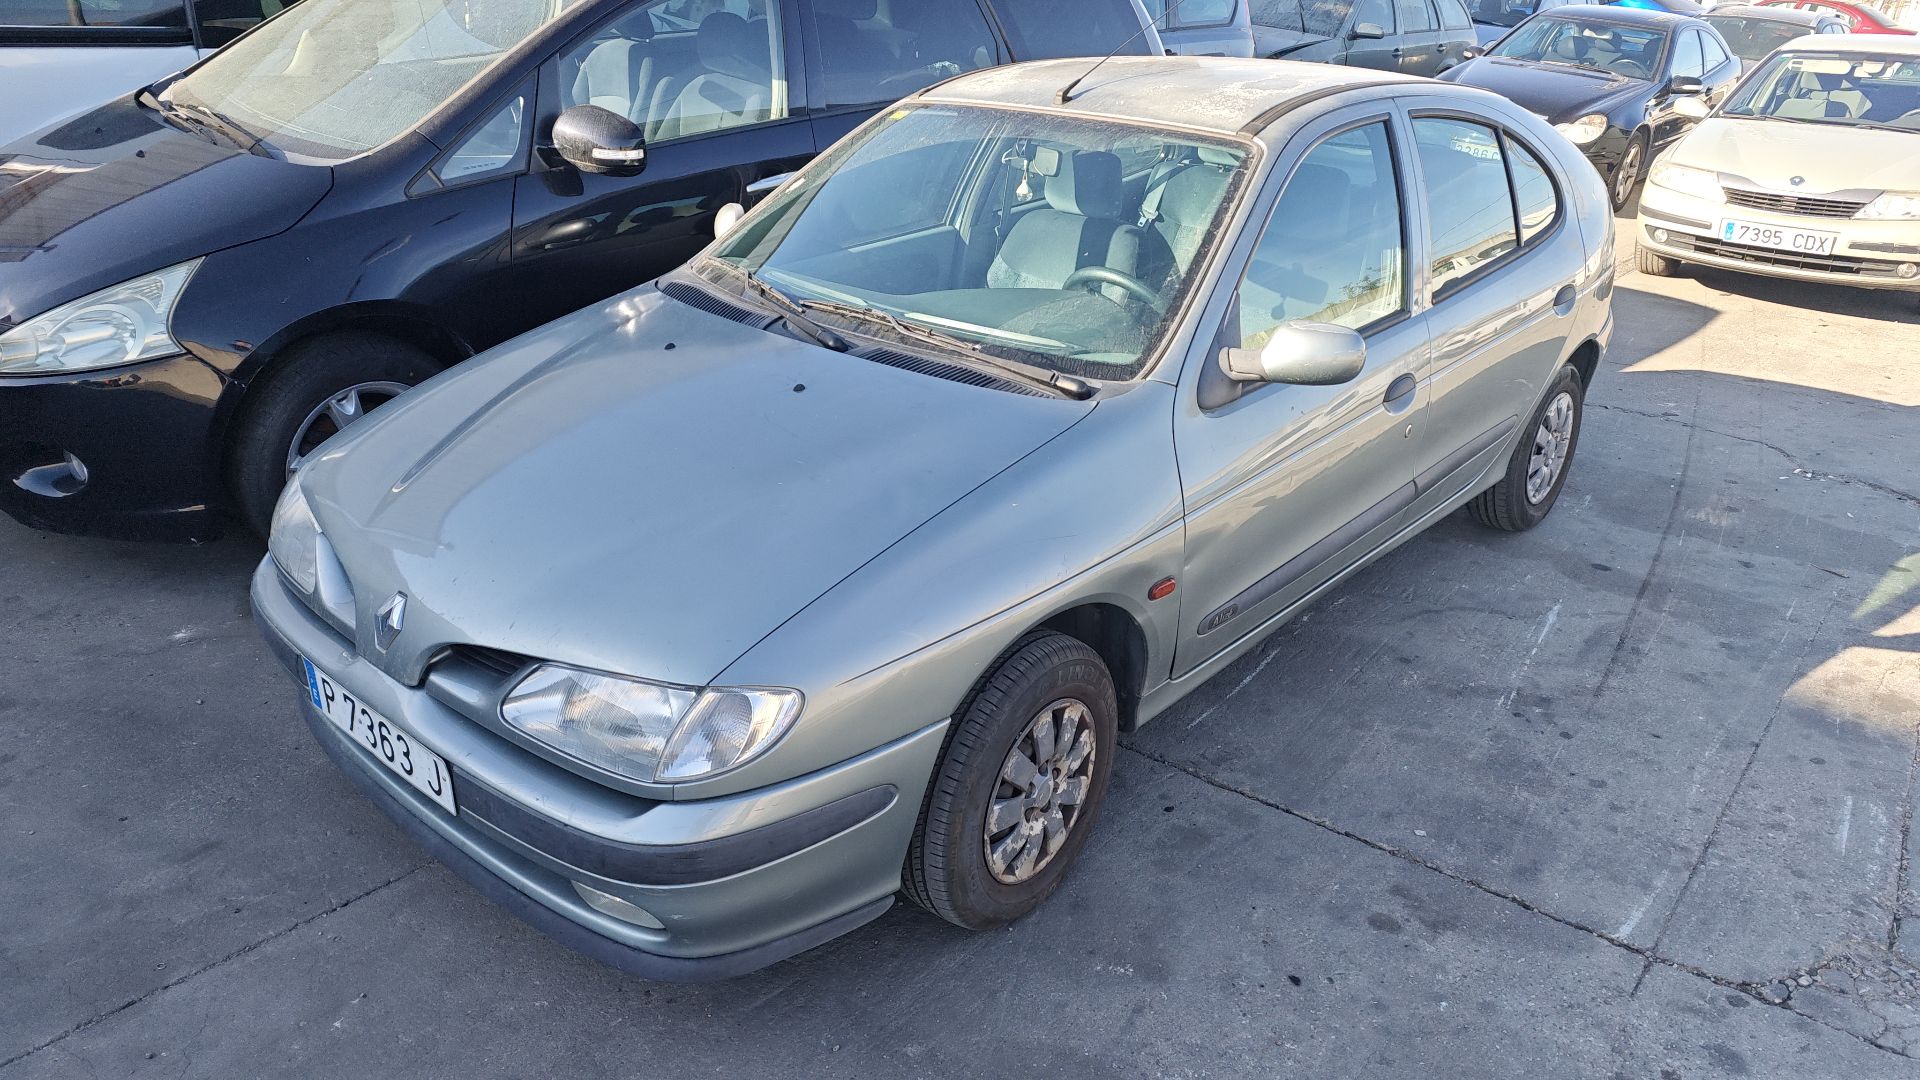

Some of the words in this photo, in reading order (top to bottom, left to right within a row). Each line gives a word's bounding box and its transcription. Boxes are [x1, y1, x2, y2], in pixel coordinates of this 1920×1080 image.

[1738, 225, 1783, 246] 7395
[1792, 233, 1829, 253] CDX
[321, 676, 335, 714] P
[343, 692, 414, 776] 7363
[427, 759, 442, 797] J
